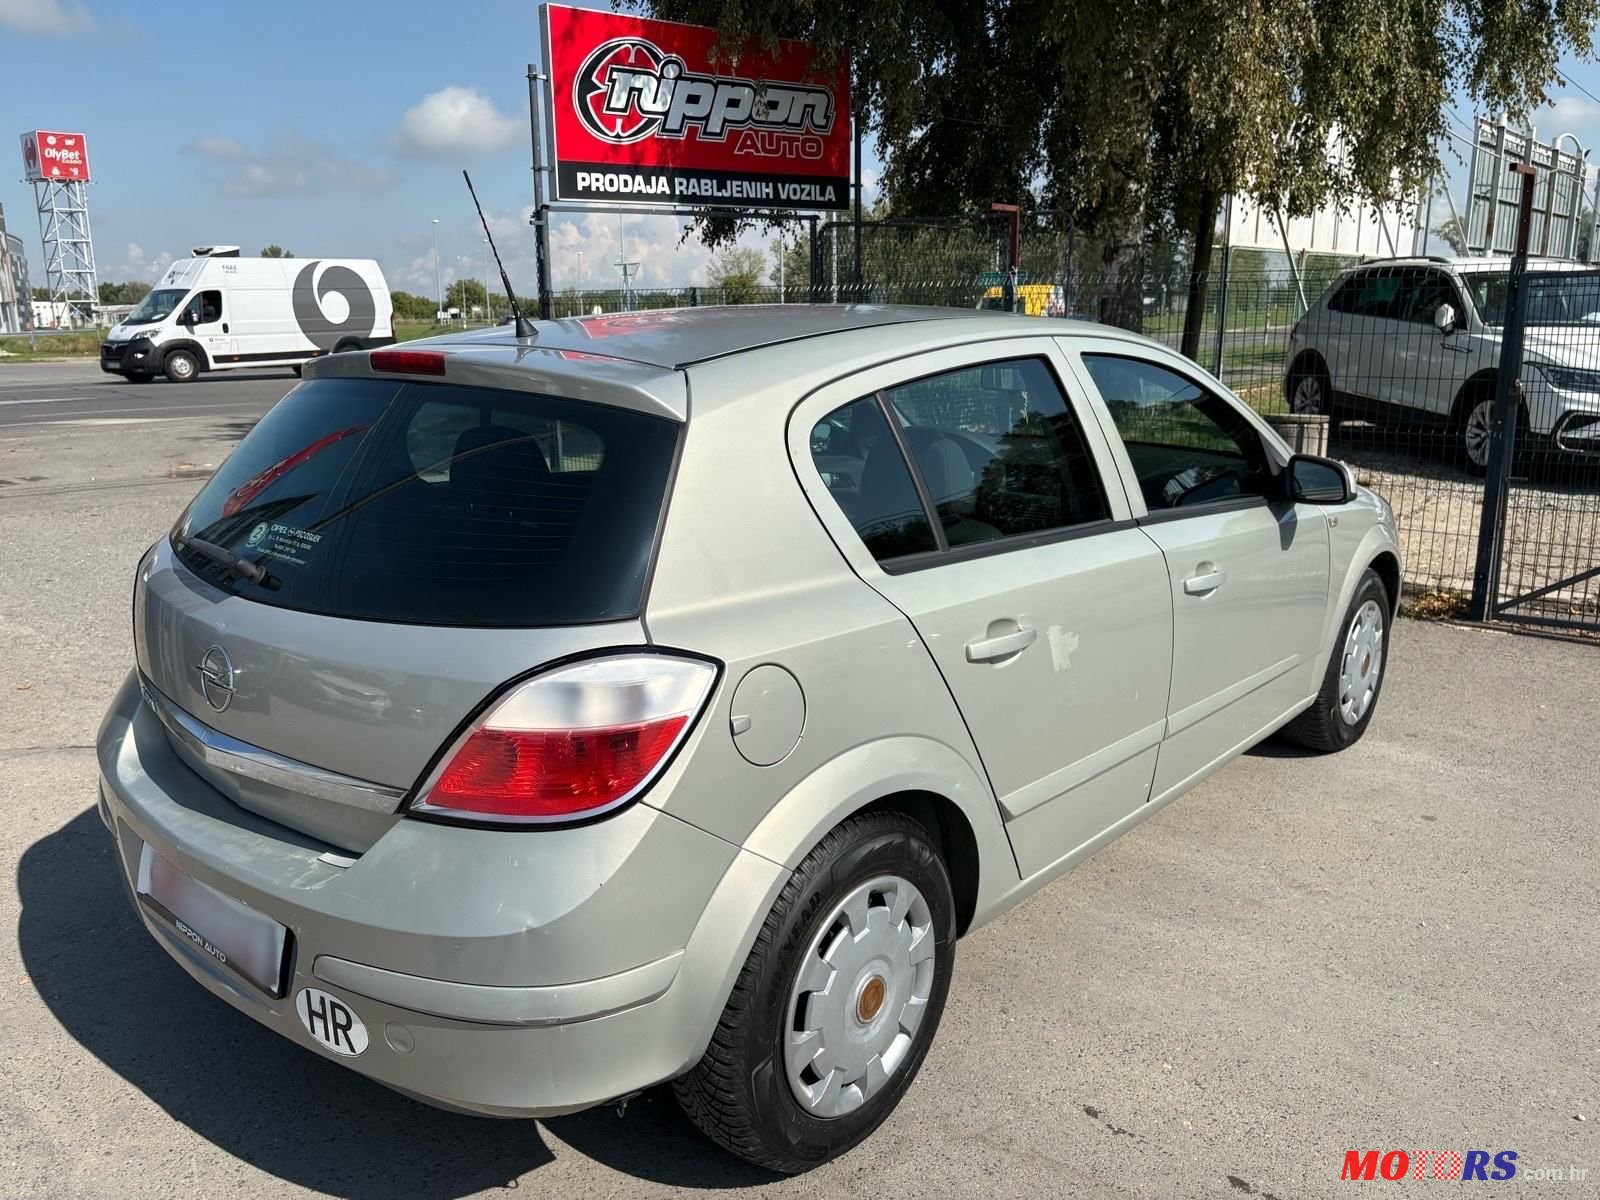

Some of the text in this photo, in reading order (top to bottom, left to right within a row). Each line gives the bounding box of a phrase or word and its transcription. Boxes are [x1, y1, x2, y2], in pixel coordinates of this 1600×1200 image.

[603, 60, 834, 137] nippon
[44, 147, 80, 161] OlyBet
[734, 131, 824, 160] AUTO
[576, 171, 837, 203] PRODAJA RABLJENIH VOZILA
[270, 523, 289, 534] OPEL
[175, 919, 226, 963] NIPPON AUTO
[305, 988, 357, 1055] HR
